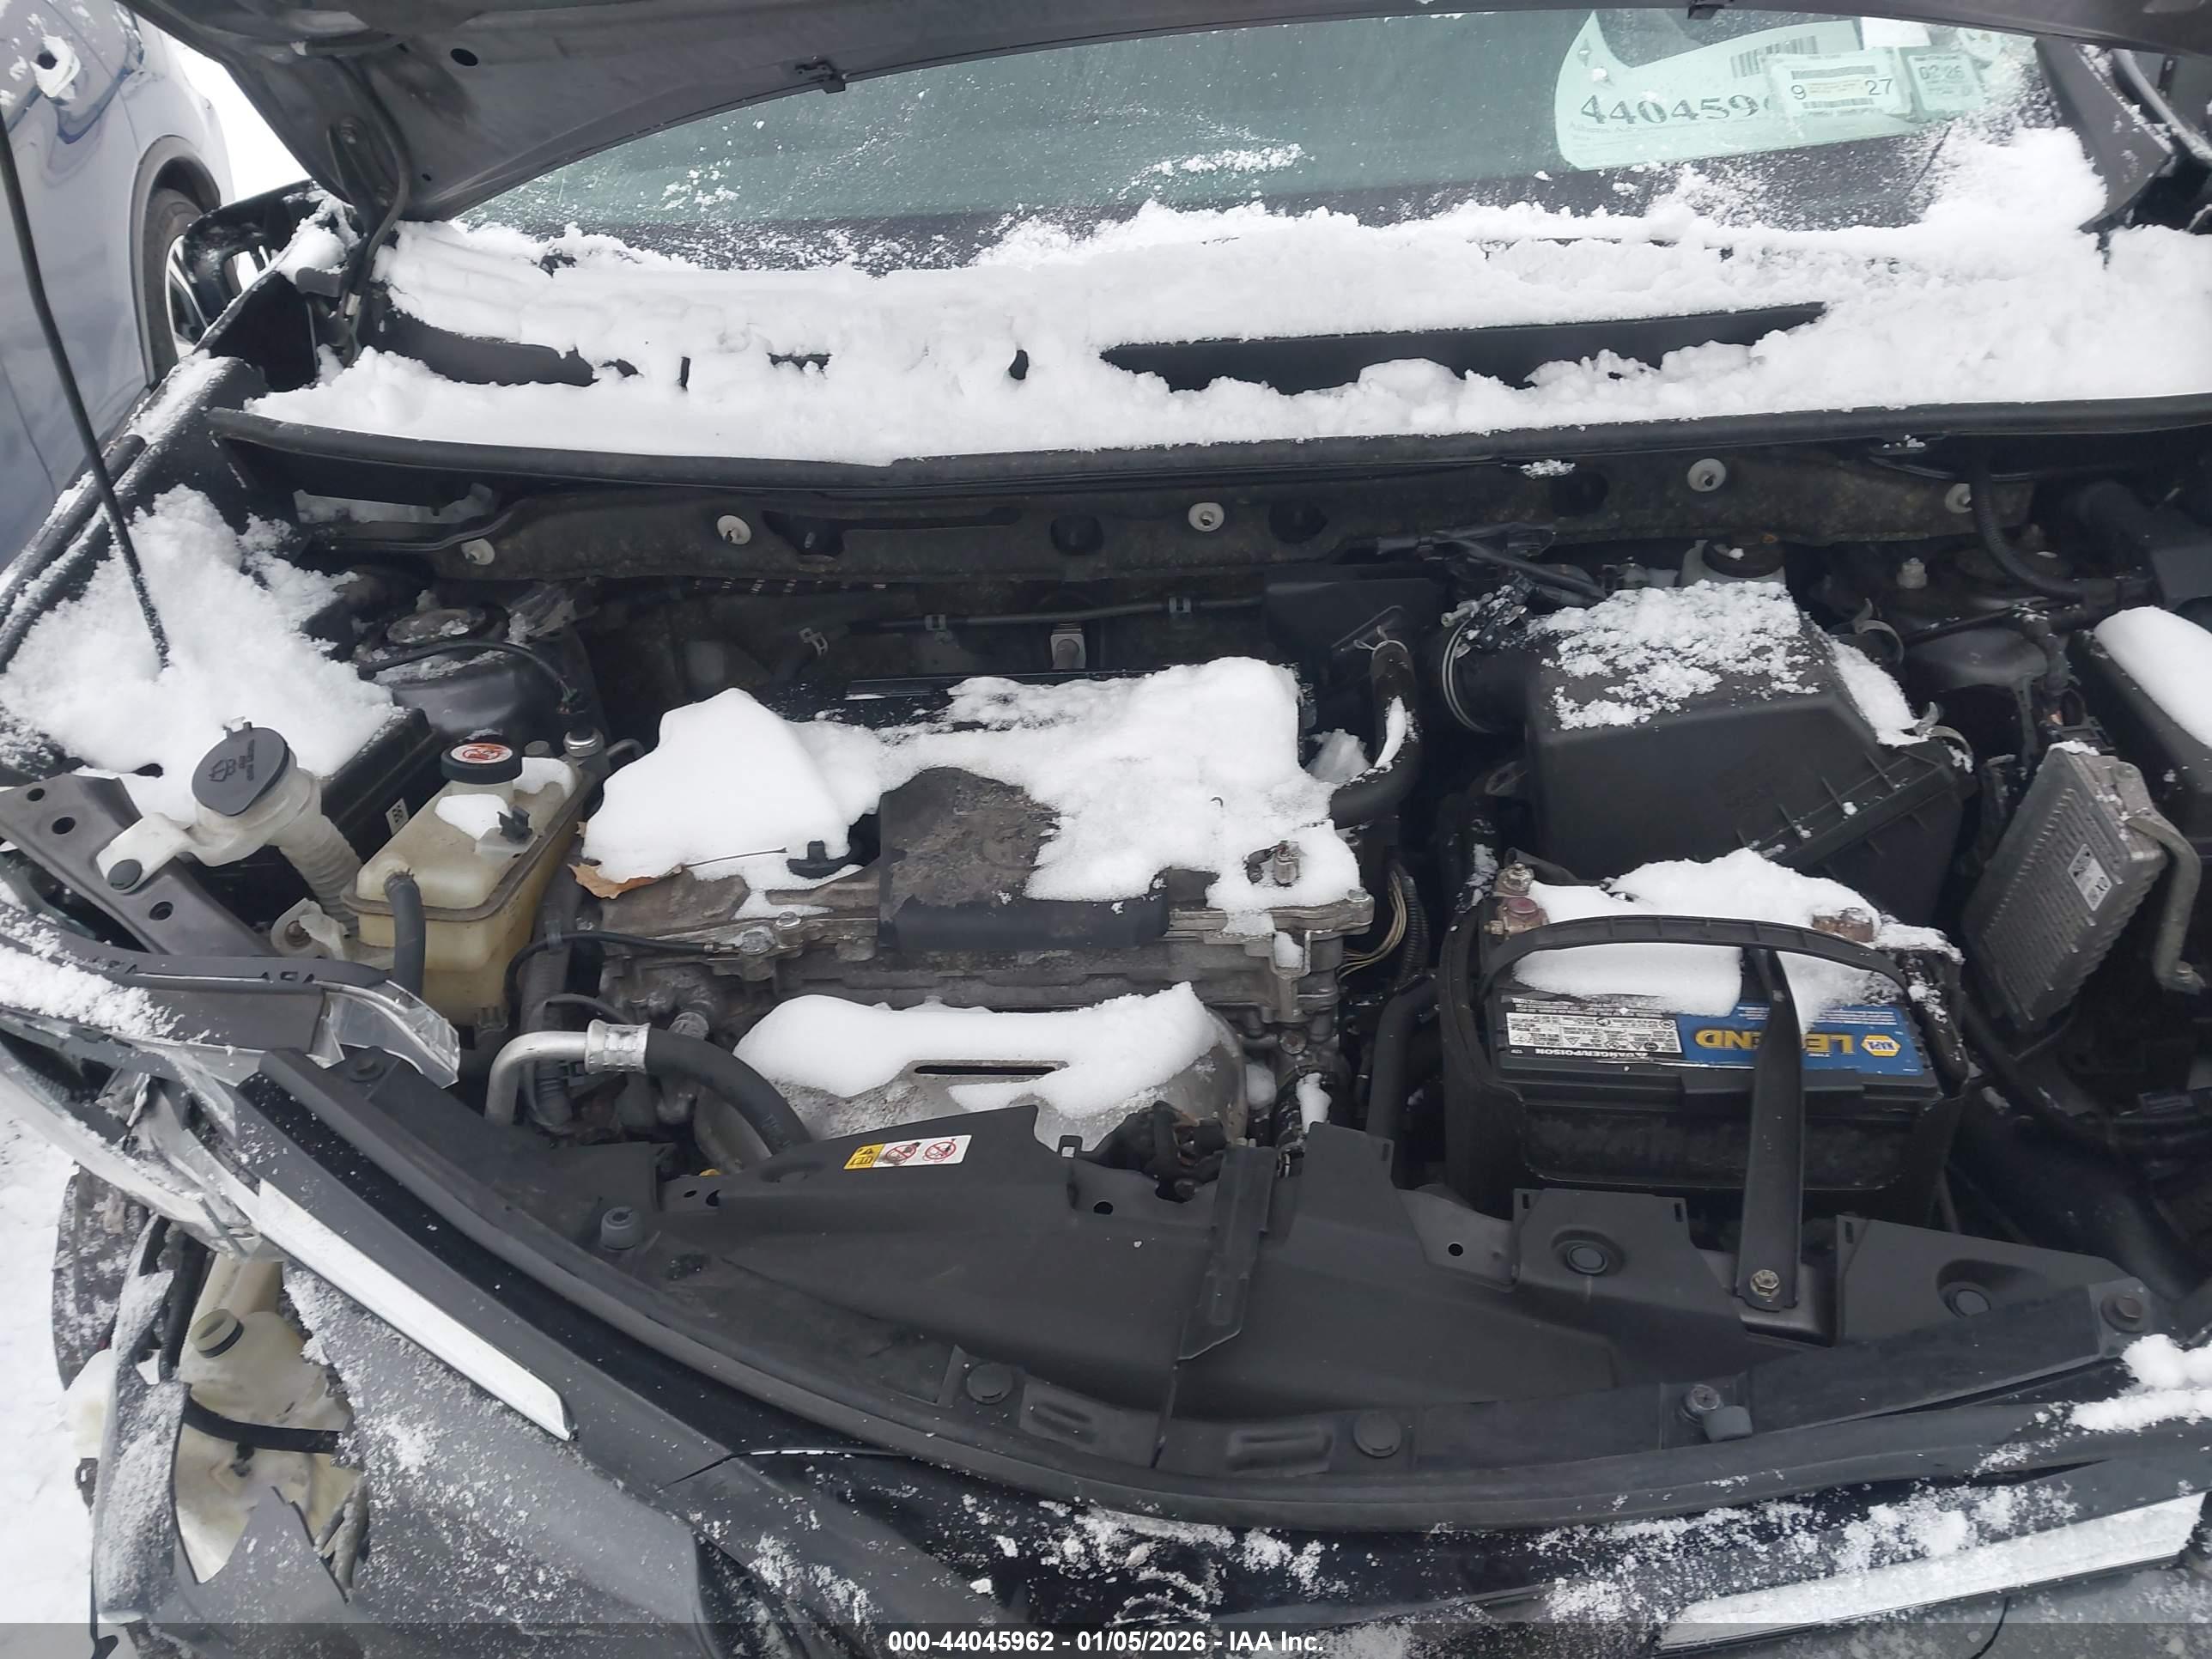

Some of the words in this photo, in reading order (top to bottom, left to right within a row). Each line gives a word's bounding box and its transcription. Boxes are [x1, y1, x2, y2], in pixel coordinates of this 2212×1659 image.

[1790, 84, 1807, 100] 9
[1864, 78, 1894, 96] 27
[1581, 94, 1770, 125] 440459
[1695, 1029, 1855, 1054] LEND
